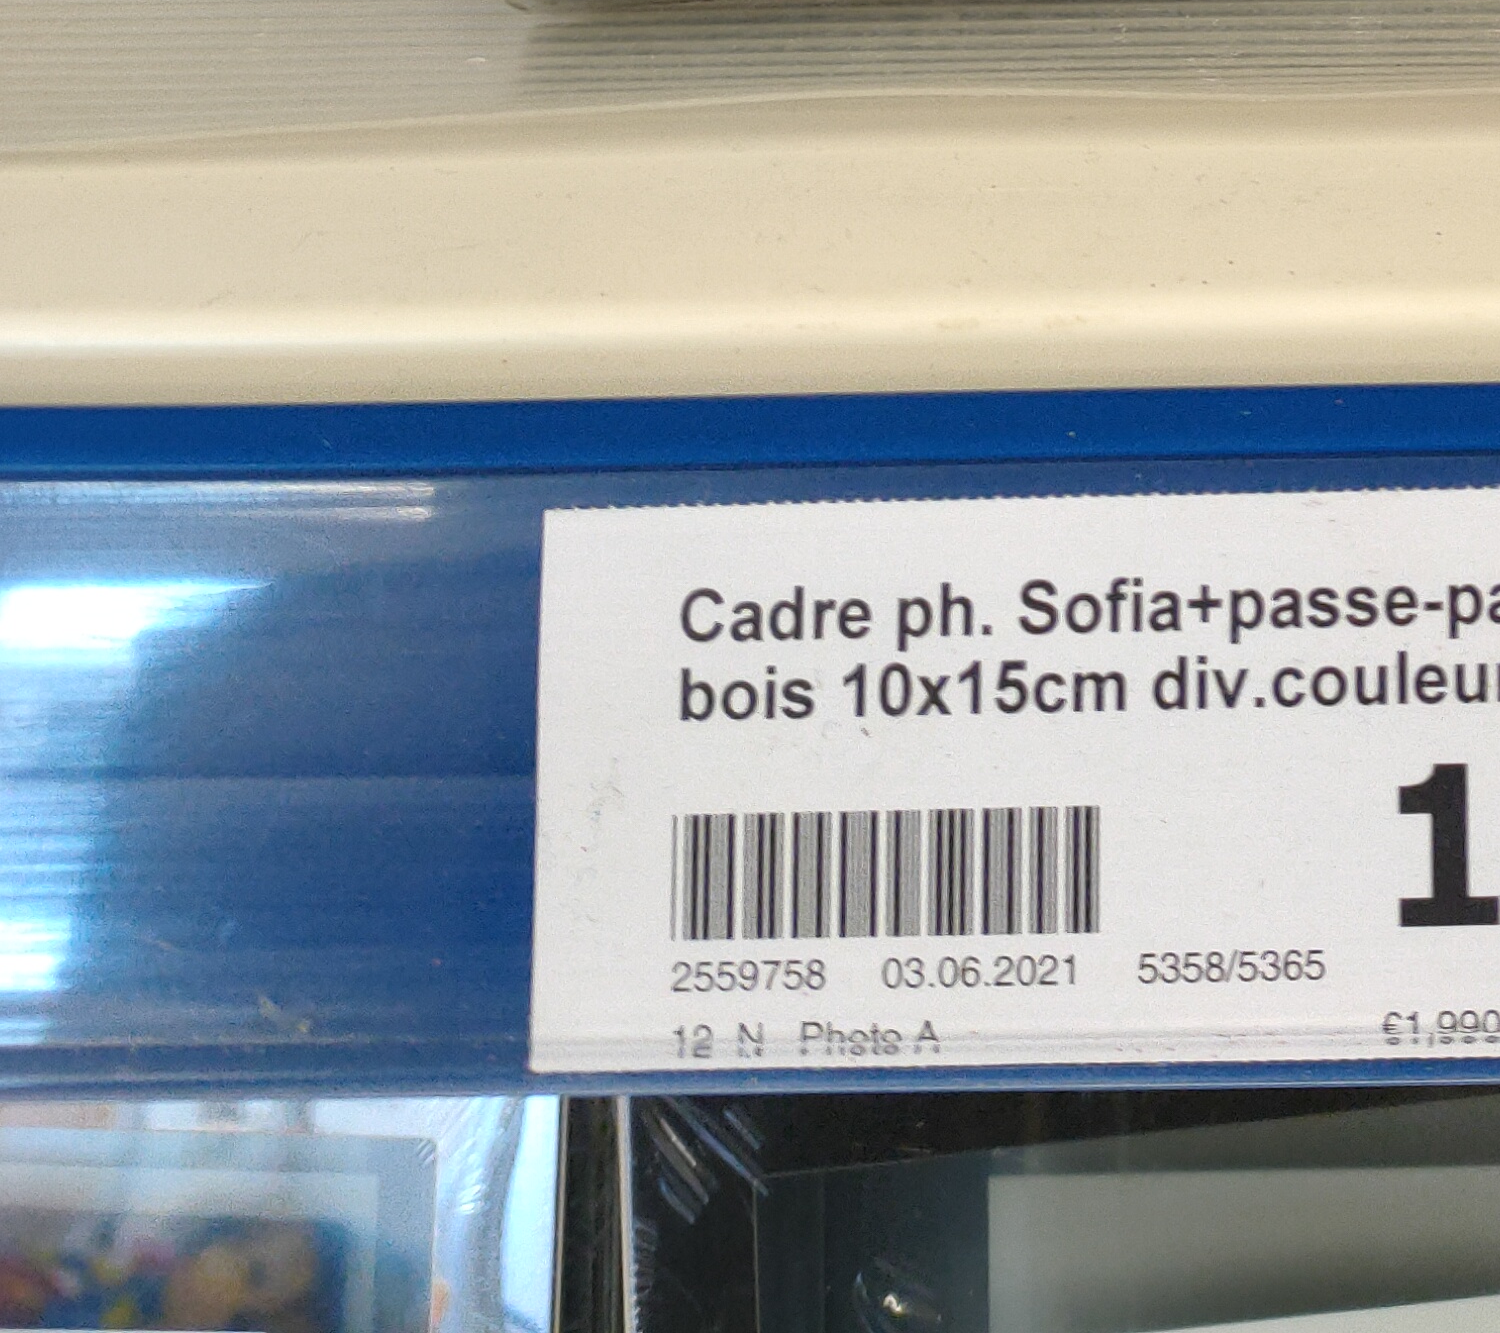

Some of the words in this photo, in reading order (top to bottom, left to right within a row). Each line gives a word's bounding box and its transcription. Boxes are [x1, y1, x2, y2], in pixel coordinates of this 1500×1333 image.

[678, 583, 873, 644] Cadre
[895, 579, 996, 656] ph.
[678, 662, 817, 724] bois
[840, 661, 1128, 719] 10x15cm
[670, 958, 829, 993] 2559758
[880, 954, 1079, 990] 03.06.2021
[1136, 948, 1327, 985] 5358/5365
[672, 1023, 715, 1059] 12
[737, 1021, 765, 1059] N
[798, 1020, 902, 1058] Photo
[916, 1019, 942, 1055] A
